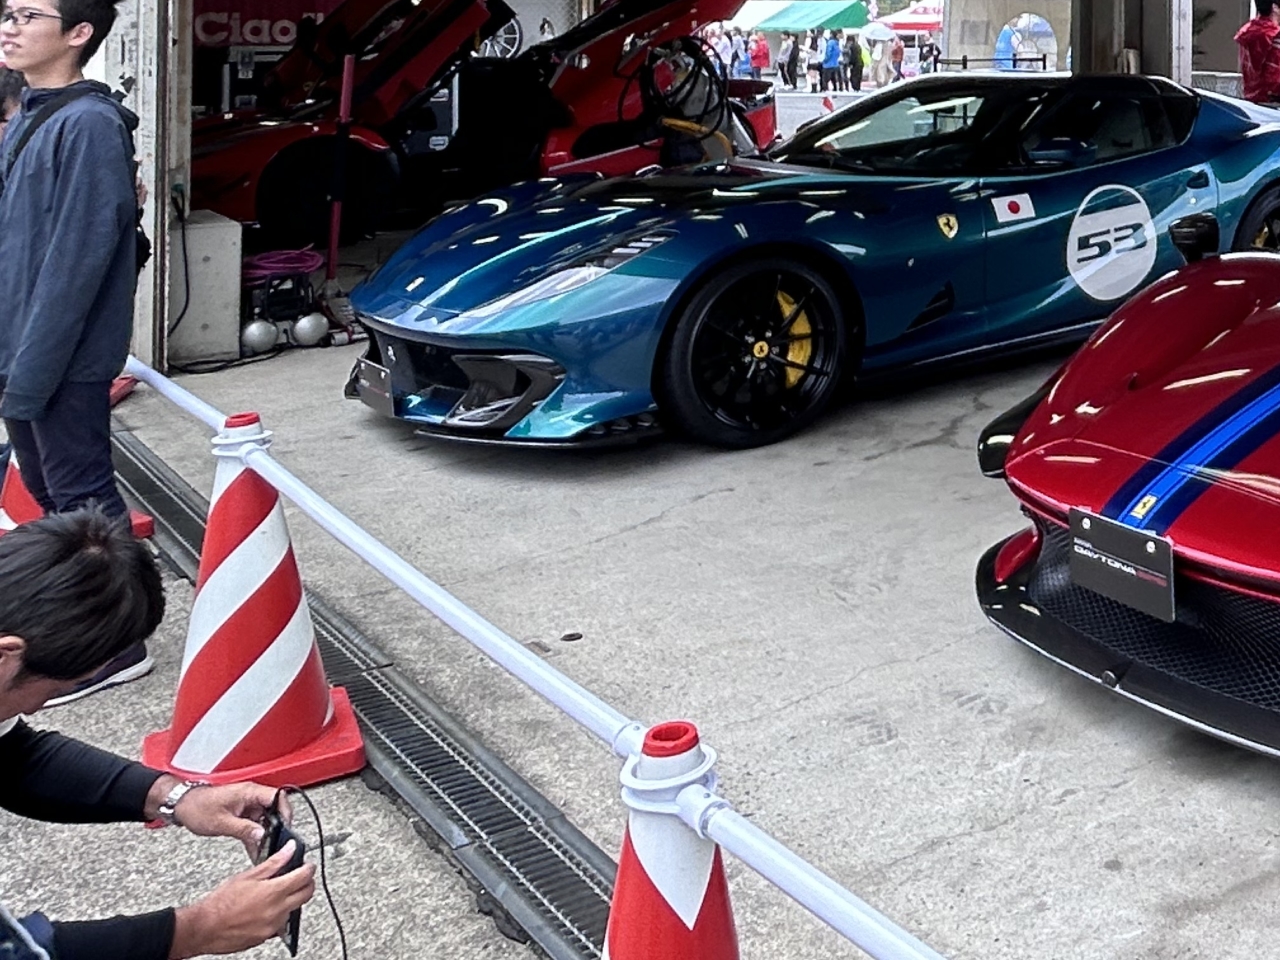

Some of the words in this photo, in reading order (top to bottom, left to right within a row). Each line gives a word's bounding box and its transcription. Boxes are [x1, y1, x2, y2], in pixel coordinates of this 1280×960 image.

[194, 11, 298, 44] Ciao
[1076, 222, 1148, 264] 53
[1073, 544, 1137, 577] DAYTONA
